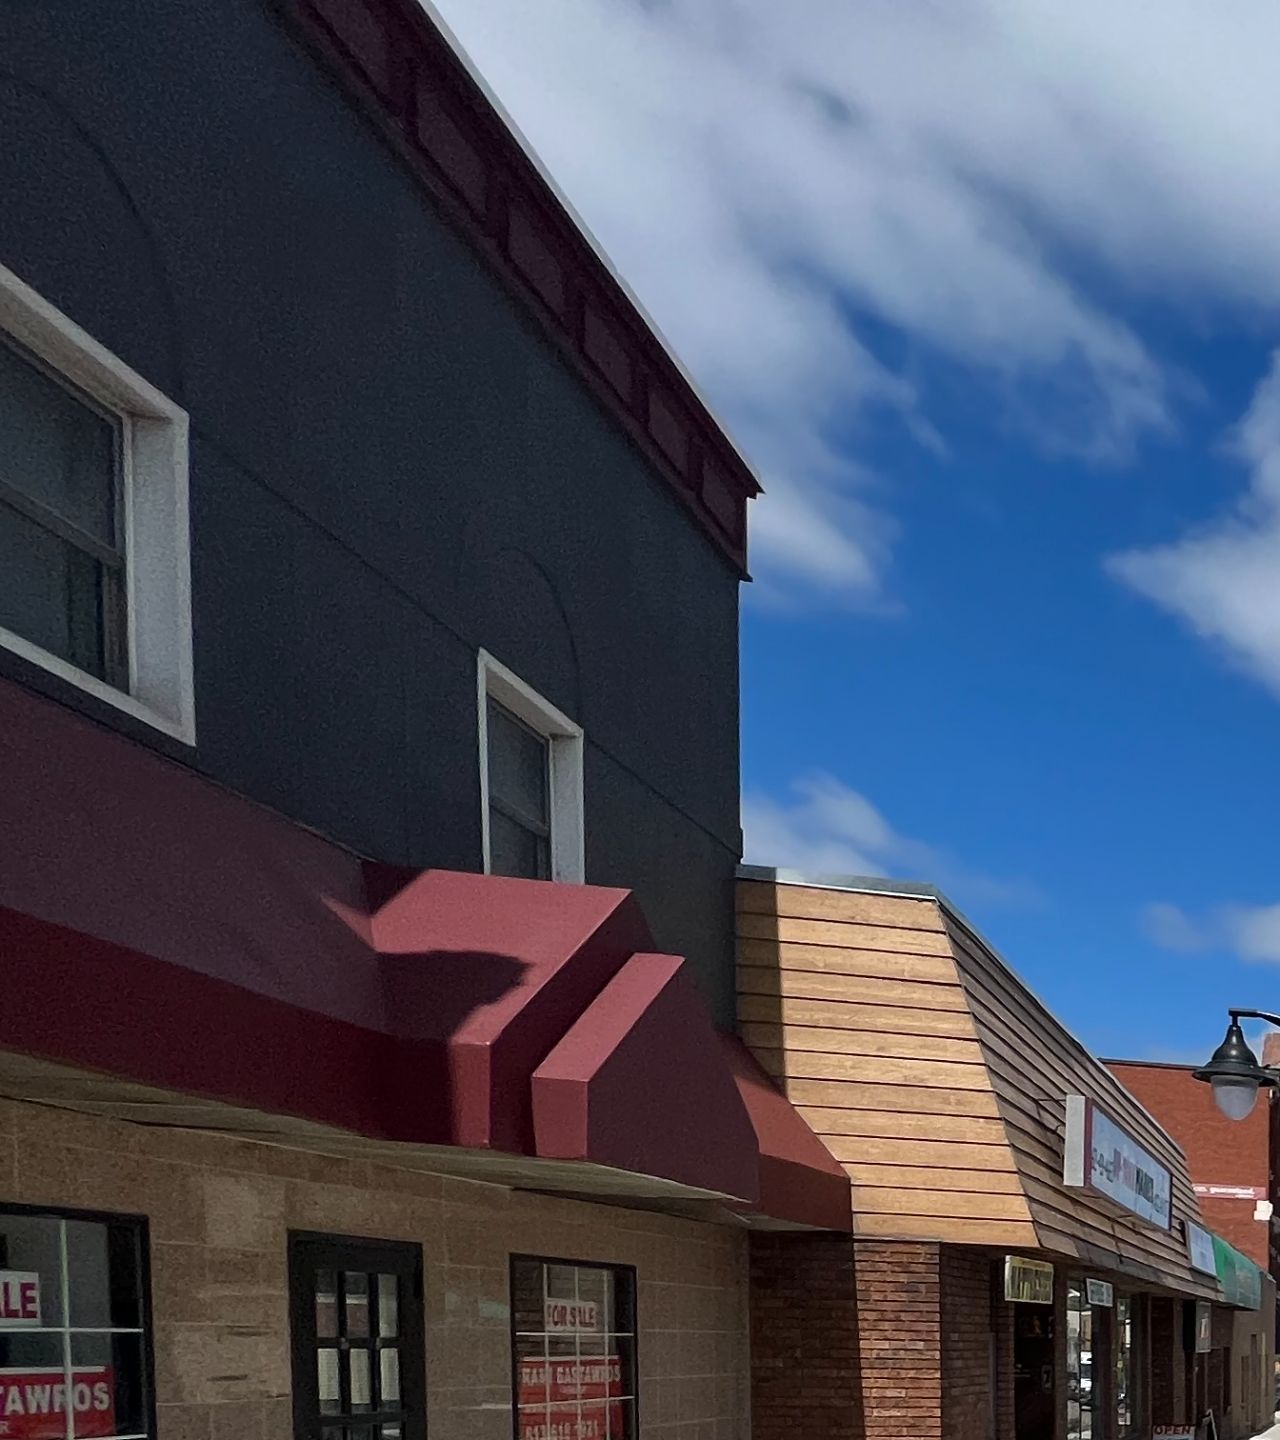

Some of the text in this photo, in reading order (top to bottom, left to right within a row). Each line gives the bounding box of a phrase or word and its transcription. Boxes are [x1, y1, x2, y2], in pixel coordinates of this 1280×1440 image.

[0, 1282, 38, 1318] LE
[547, 1303, 595, 1328] FOR SALE
[0, 1382, 110, 1415] AWROS
[1154, 1426, 1191, 1435] OPEN
